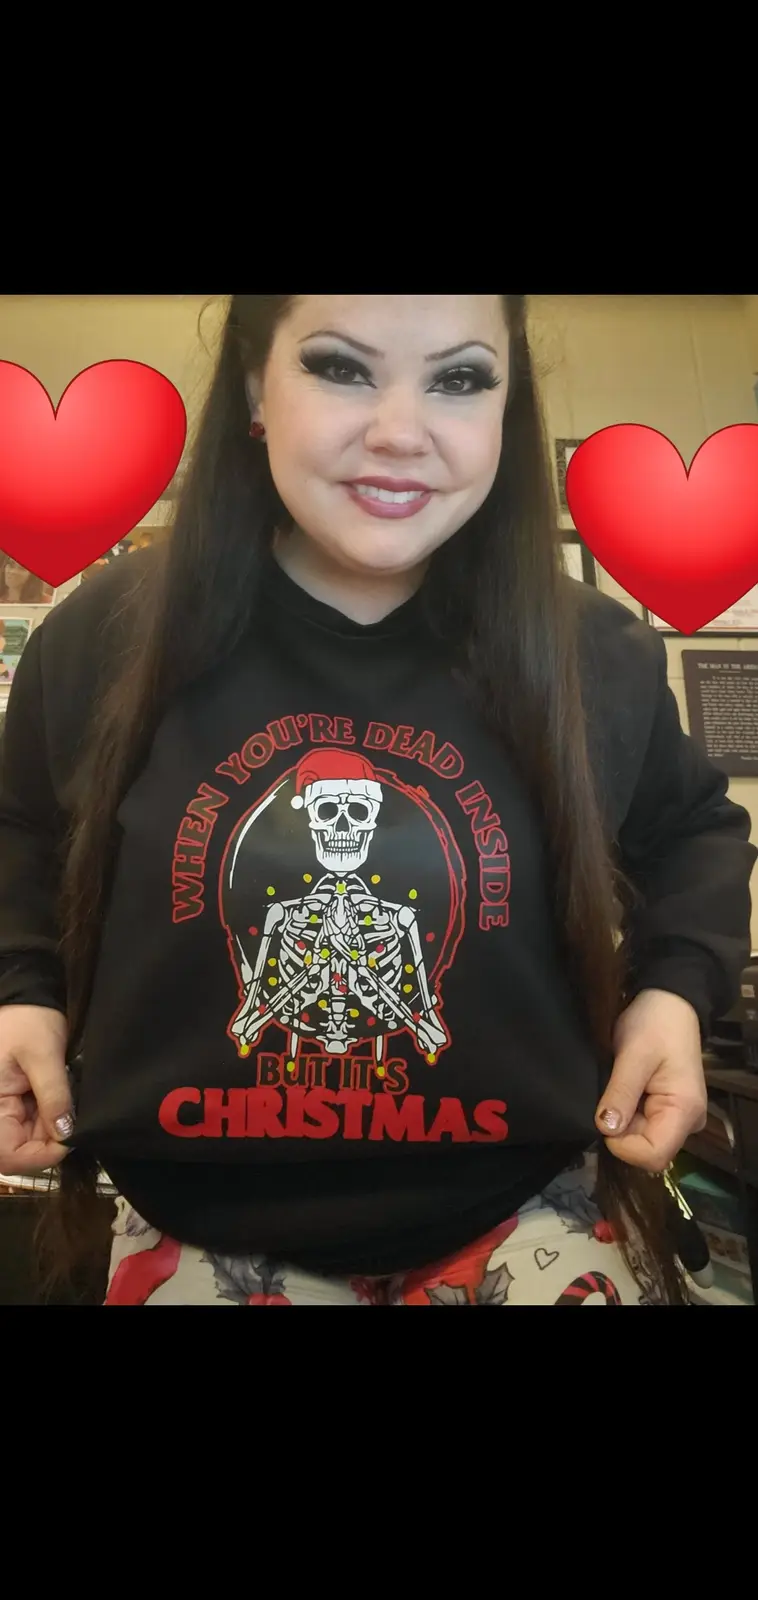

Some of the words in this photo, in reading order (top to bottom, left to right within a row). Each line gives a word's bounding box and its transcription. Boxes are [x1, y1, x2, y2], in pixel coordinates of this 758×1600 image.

[172, 783, 229, 923] WHEN
[216, 714, 356, 785] YOU'RE
[363, 722, 464, 779] DEAD
[456, 781, 511, 931] INSIDE
[256, 1052, 332, 1088] BUT
[158, 1087, 509, 1143] CHRISTMAS
